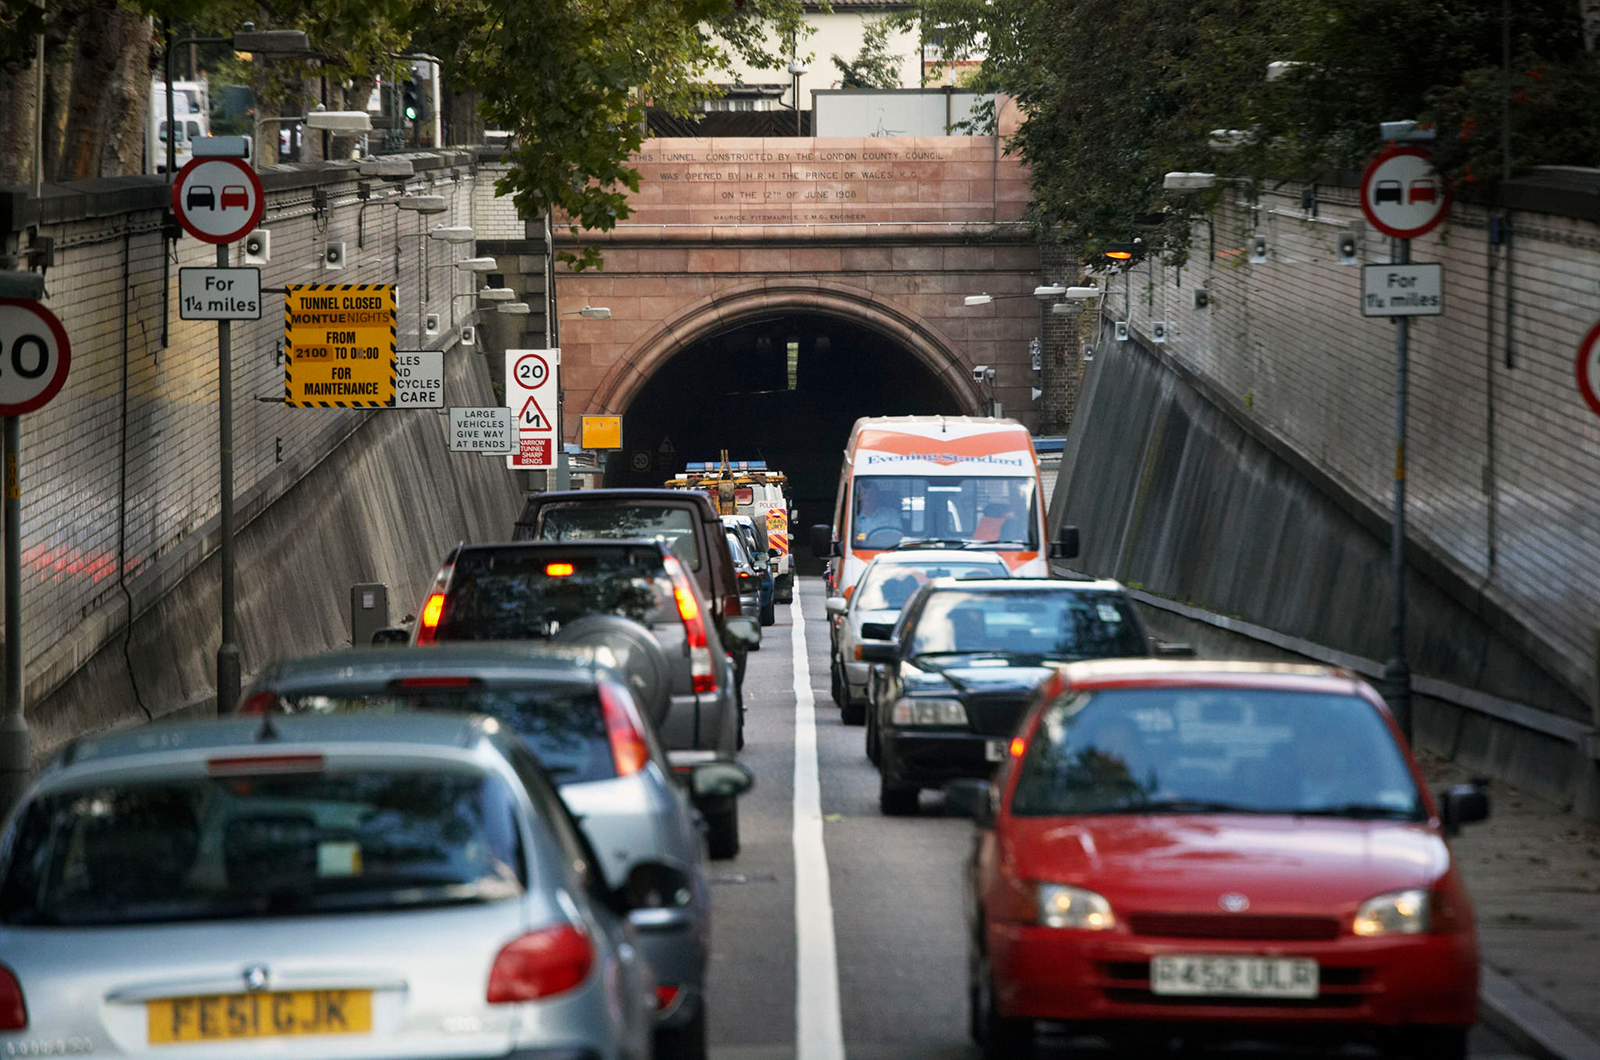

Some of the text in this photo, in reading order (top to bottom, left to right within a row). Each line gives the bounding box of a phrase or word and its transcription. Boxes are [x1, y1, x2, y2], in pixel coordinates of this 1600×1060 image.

[633, 154, 653, 162] THIS
[662, 154, 697, 162] TUNNEL
[705, 154, 773, 162] CONSTRUCTED
[820, 153, 857, 161] LONDON
[862, 152, 899, 160] COUNTY
[905, 152, 944, 160] COUNCIL
[782, 172, 799, 180] THE
[805, 172, 839, 180] PRINCE
[861, 171, 893, 179] WALES
[721, 191, 735, 199] ON
[740, 191, 757, 199] THE
[786, 191, 797, 199] OF
[804, 191, 829, 199] JUNE
[835, 191, 857, 199] 1908
[205, 276, 234, 291] For
[1387, 273, 1418, 288] For
[207, 297, 256, 312] miles
[300, 297, 382, 310] TUNNEL CLOSED
[1390, 292, 1439, 307] miles
[346, 312, 390, 323] NIGHTS
[326, 331, 356, 344] FROM
[0, 334, 50, 379] 0
[296, 347, 328, 358] 2100
[335, 347, 347, 359] TO
[331, 367, 352, 380] FOR
[520, 365, 544, 378] 20
[304, 382, 379, 396] MAINTENANCE
[400, 391, 436, 403] CARE
[464, 410, 496, 418] LARGE
[456, 420, 504, 428] VEHICLES
[456, 430, 504, 438] GIVE WAY
[456, 440, 506, 448] AT BENDS
[635, 457, 647, 465] 20
[867, 452, 1023, 467] Evening Standard
